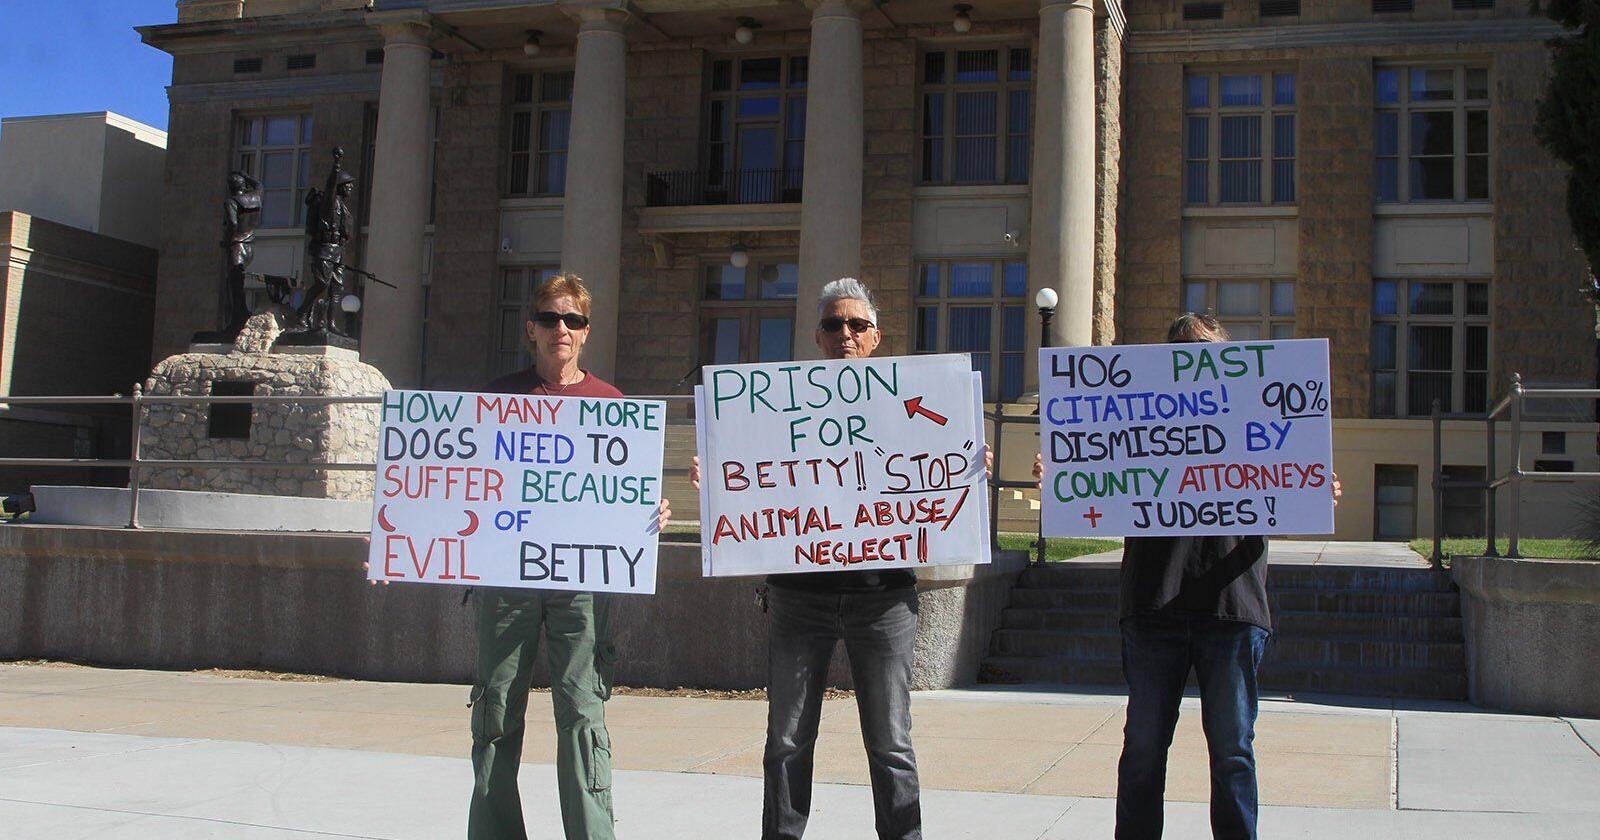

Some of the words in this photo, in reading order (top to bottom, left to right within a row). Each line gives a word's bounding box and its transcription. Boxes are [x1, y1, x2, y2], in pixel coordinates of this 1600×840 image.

[1052, 354, 1131, 388] 406
[1172, 345, 1274, 382] PAST
[383, 391, 463, 423] HOW
[477, 396, 563, 425] MANY
[579, 400, 659, 431] MORE
[713, 363, 898, 420] PRISON
[1047, 384, 1230, 425] CITATIONS!
[1262, 380, 1328, 415] 90%
[383, 427, 477, 460] DOGS
[495, 431, 574, 465] NEED
[587, 433, 628, 465] TO
[790, 415, 873, 452] FOR
[1051, 424, 1226, 463] DISMISSED
[1246, 420, 1292, 451] BY
[383, 465, 504, 501] SUFFER
[522, 469, 657, 505] BECAUSE
[1054, 467, 1169, 502] COUNTY
[1178, 463, 1325, 494] ATTORNEYS
[495, 510, 531, 532] OF
[712, 505, 842, 545] ANIMAL
[385, 534, 480, 580] EVIL
[520, 541, 644, 587] BETTY
